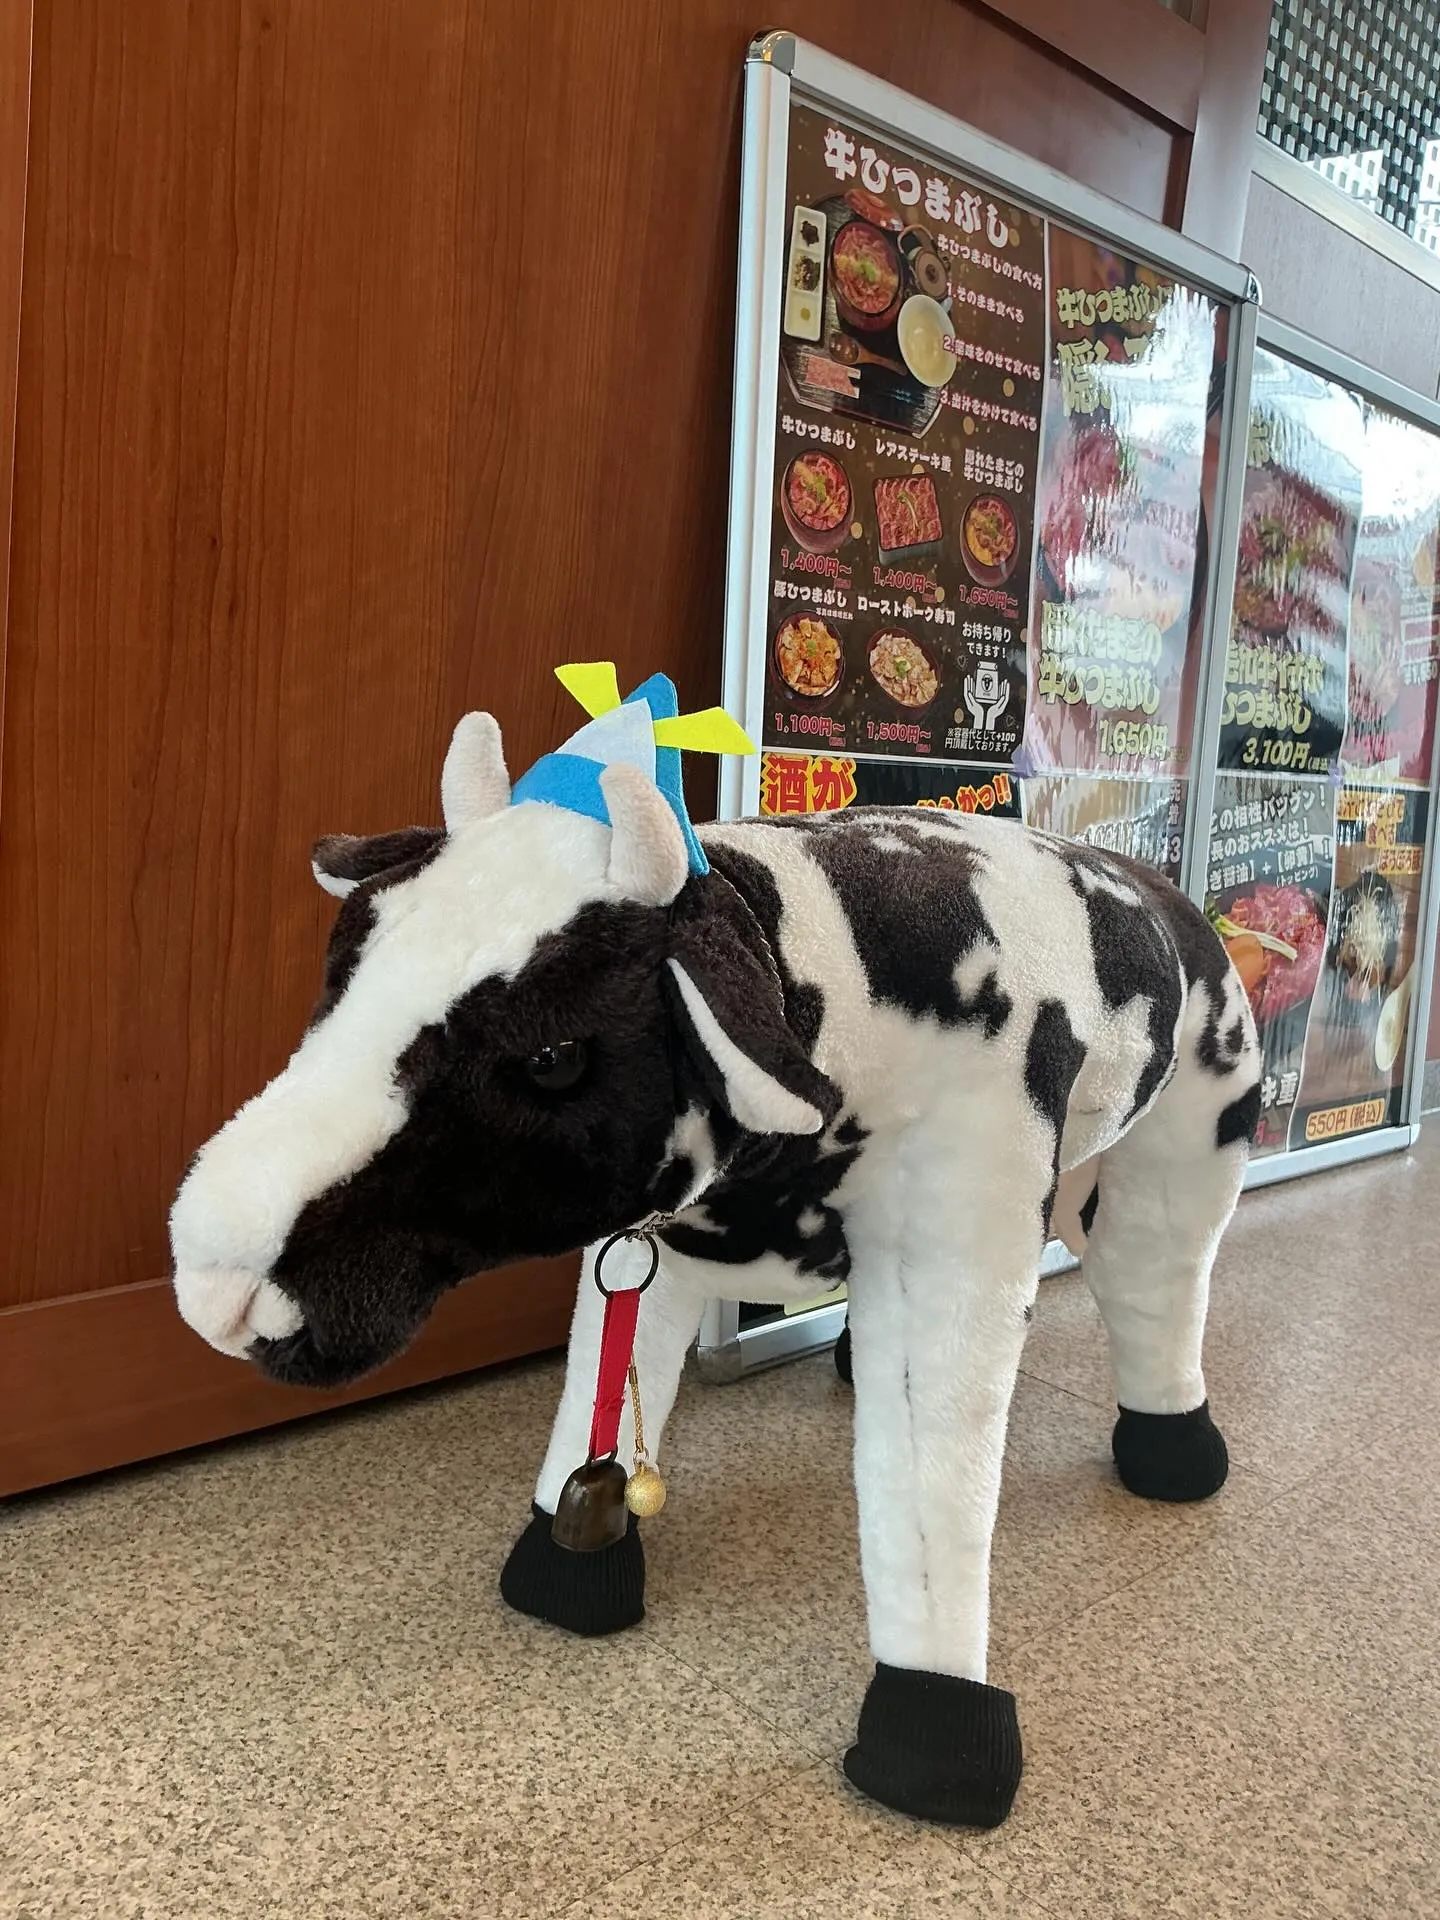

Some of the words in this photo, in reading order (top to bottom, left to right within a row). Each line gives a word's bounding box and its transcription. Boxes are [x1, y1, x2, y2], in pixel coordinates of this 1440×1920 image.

[824, 128, 1009, 248] 牛ひつまぶし
[937, 234, 1043, 291] 牛ひつまぶしの食べ方
[781, 415, 856, 450] 牛ひつまぶし
[875, 438, 952, 473] レアステーキ重
[963, 464, 1023, 494] 牛ひつまぶし
[962, 621, 1012, 643] お持ち帰り
[1038, 652, 1161, 715] 牛ひつまぶし
